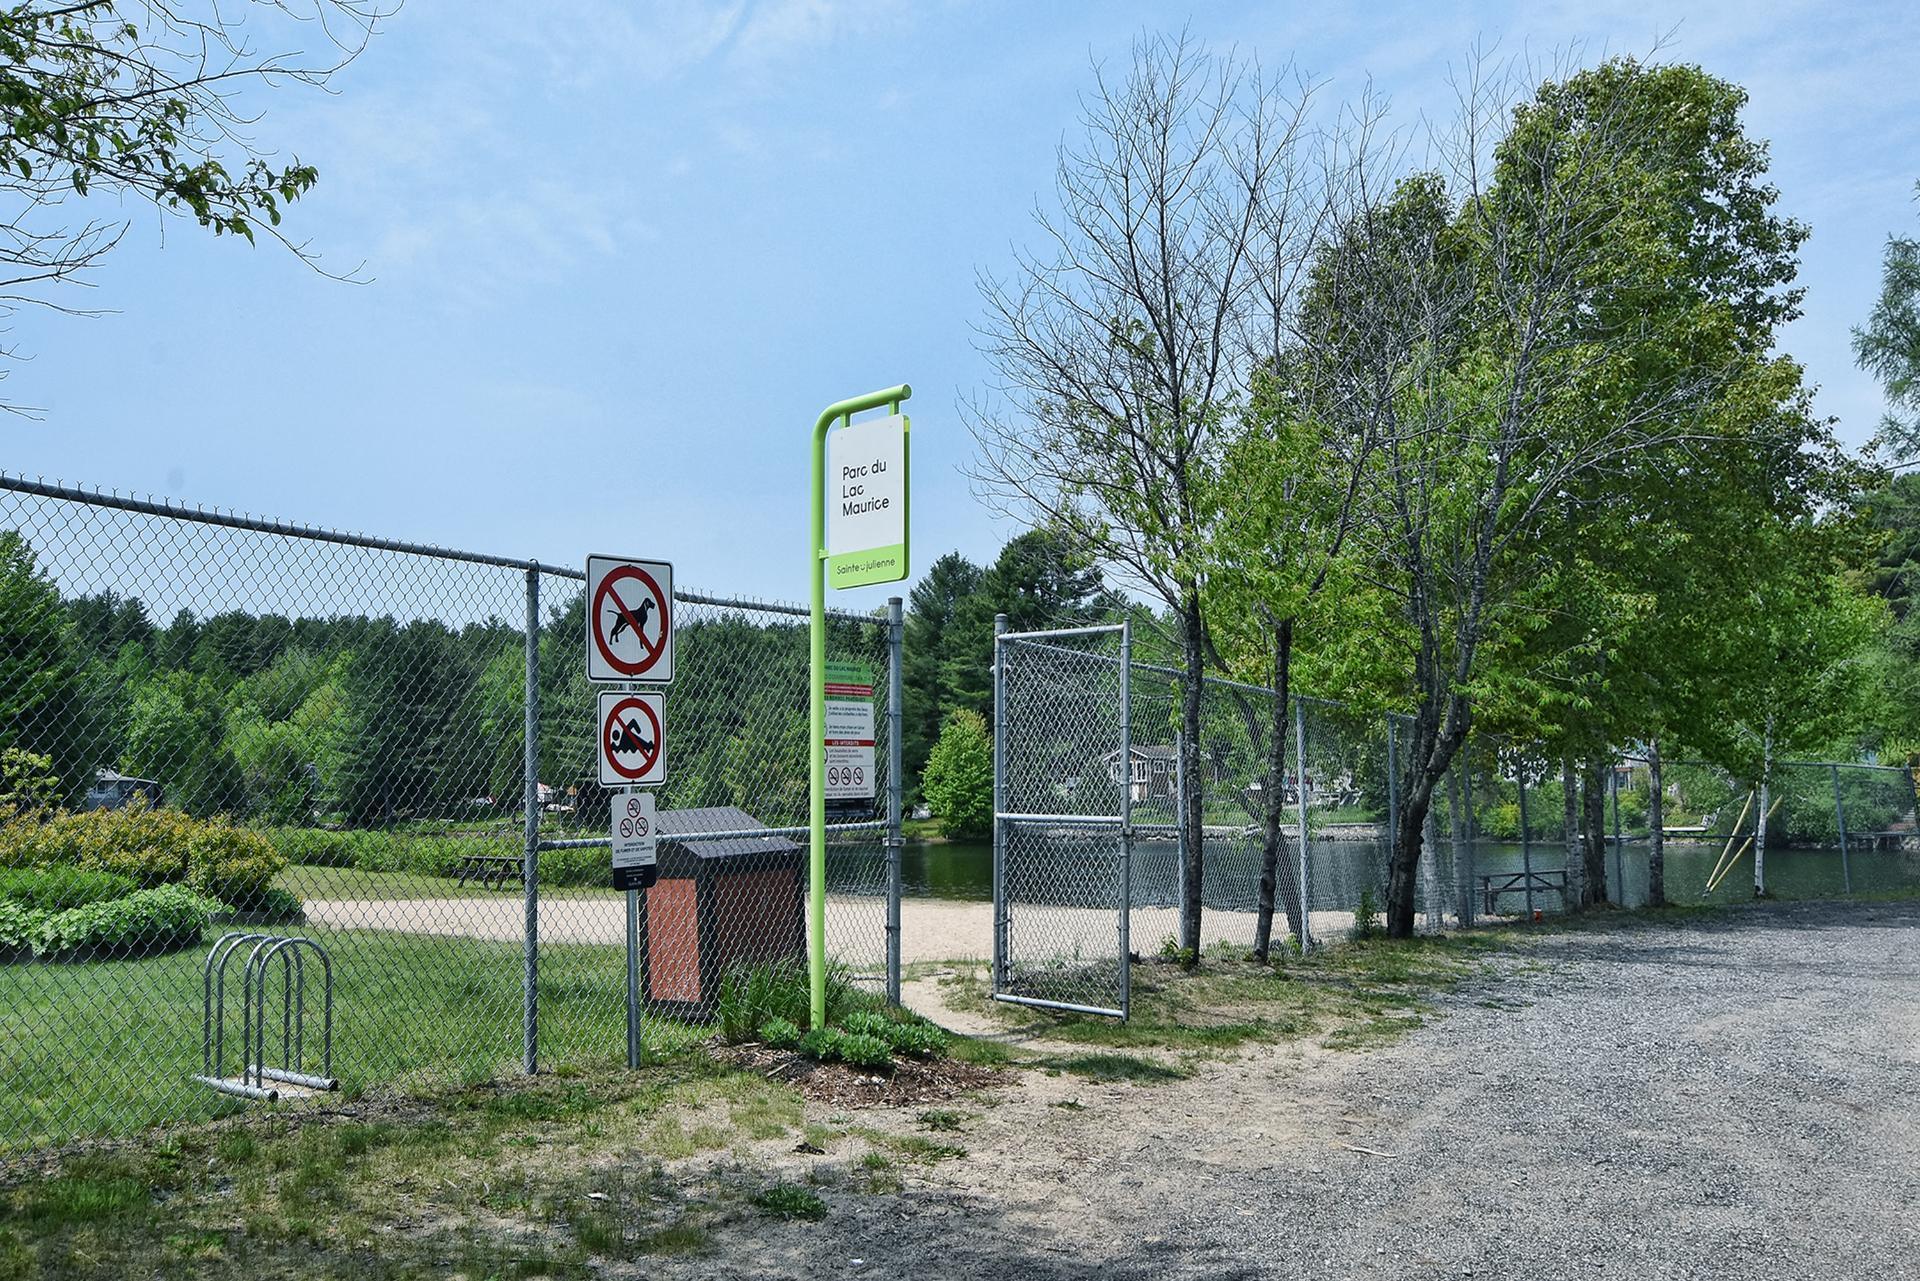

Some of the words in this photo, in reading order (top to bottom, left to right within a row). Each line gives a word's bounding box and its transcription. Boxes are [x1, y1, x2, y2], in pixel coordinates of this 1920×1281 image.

[842, 465, 868, 480] Parc
[871, 459, 887, 474] du
[842, 484, 864, 498] Lac
[842, 497, 889, 516] Maurice
[836, 563, 860, 575] Sainte
[865, 558, 896, 572] julienne
